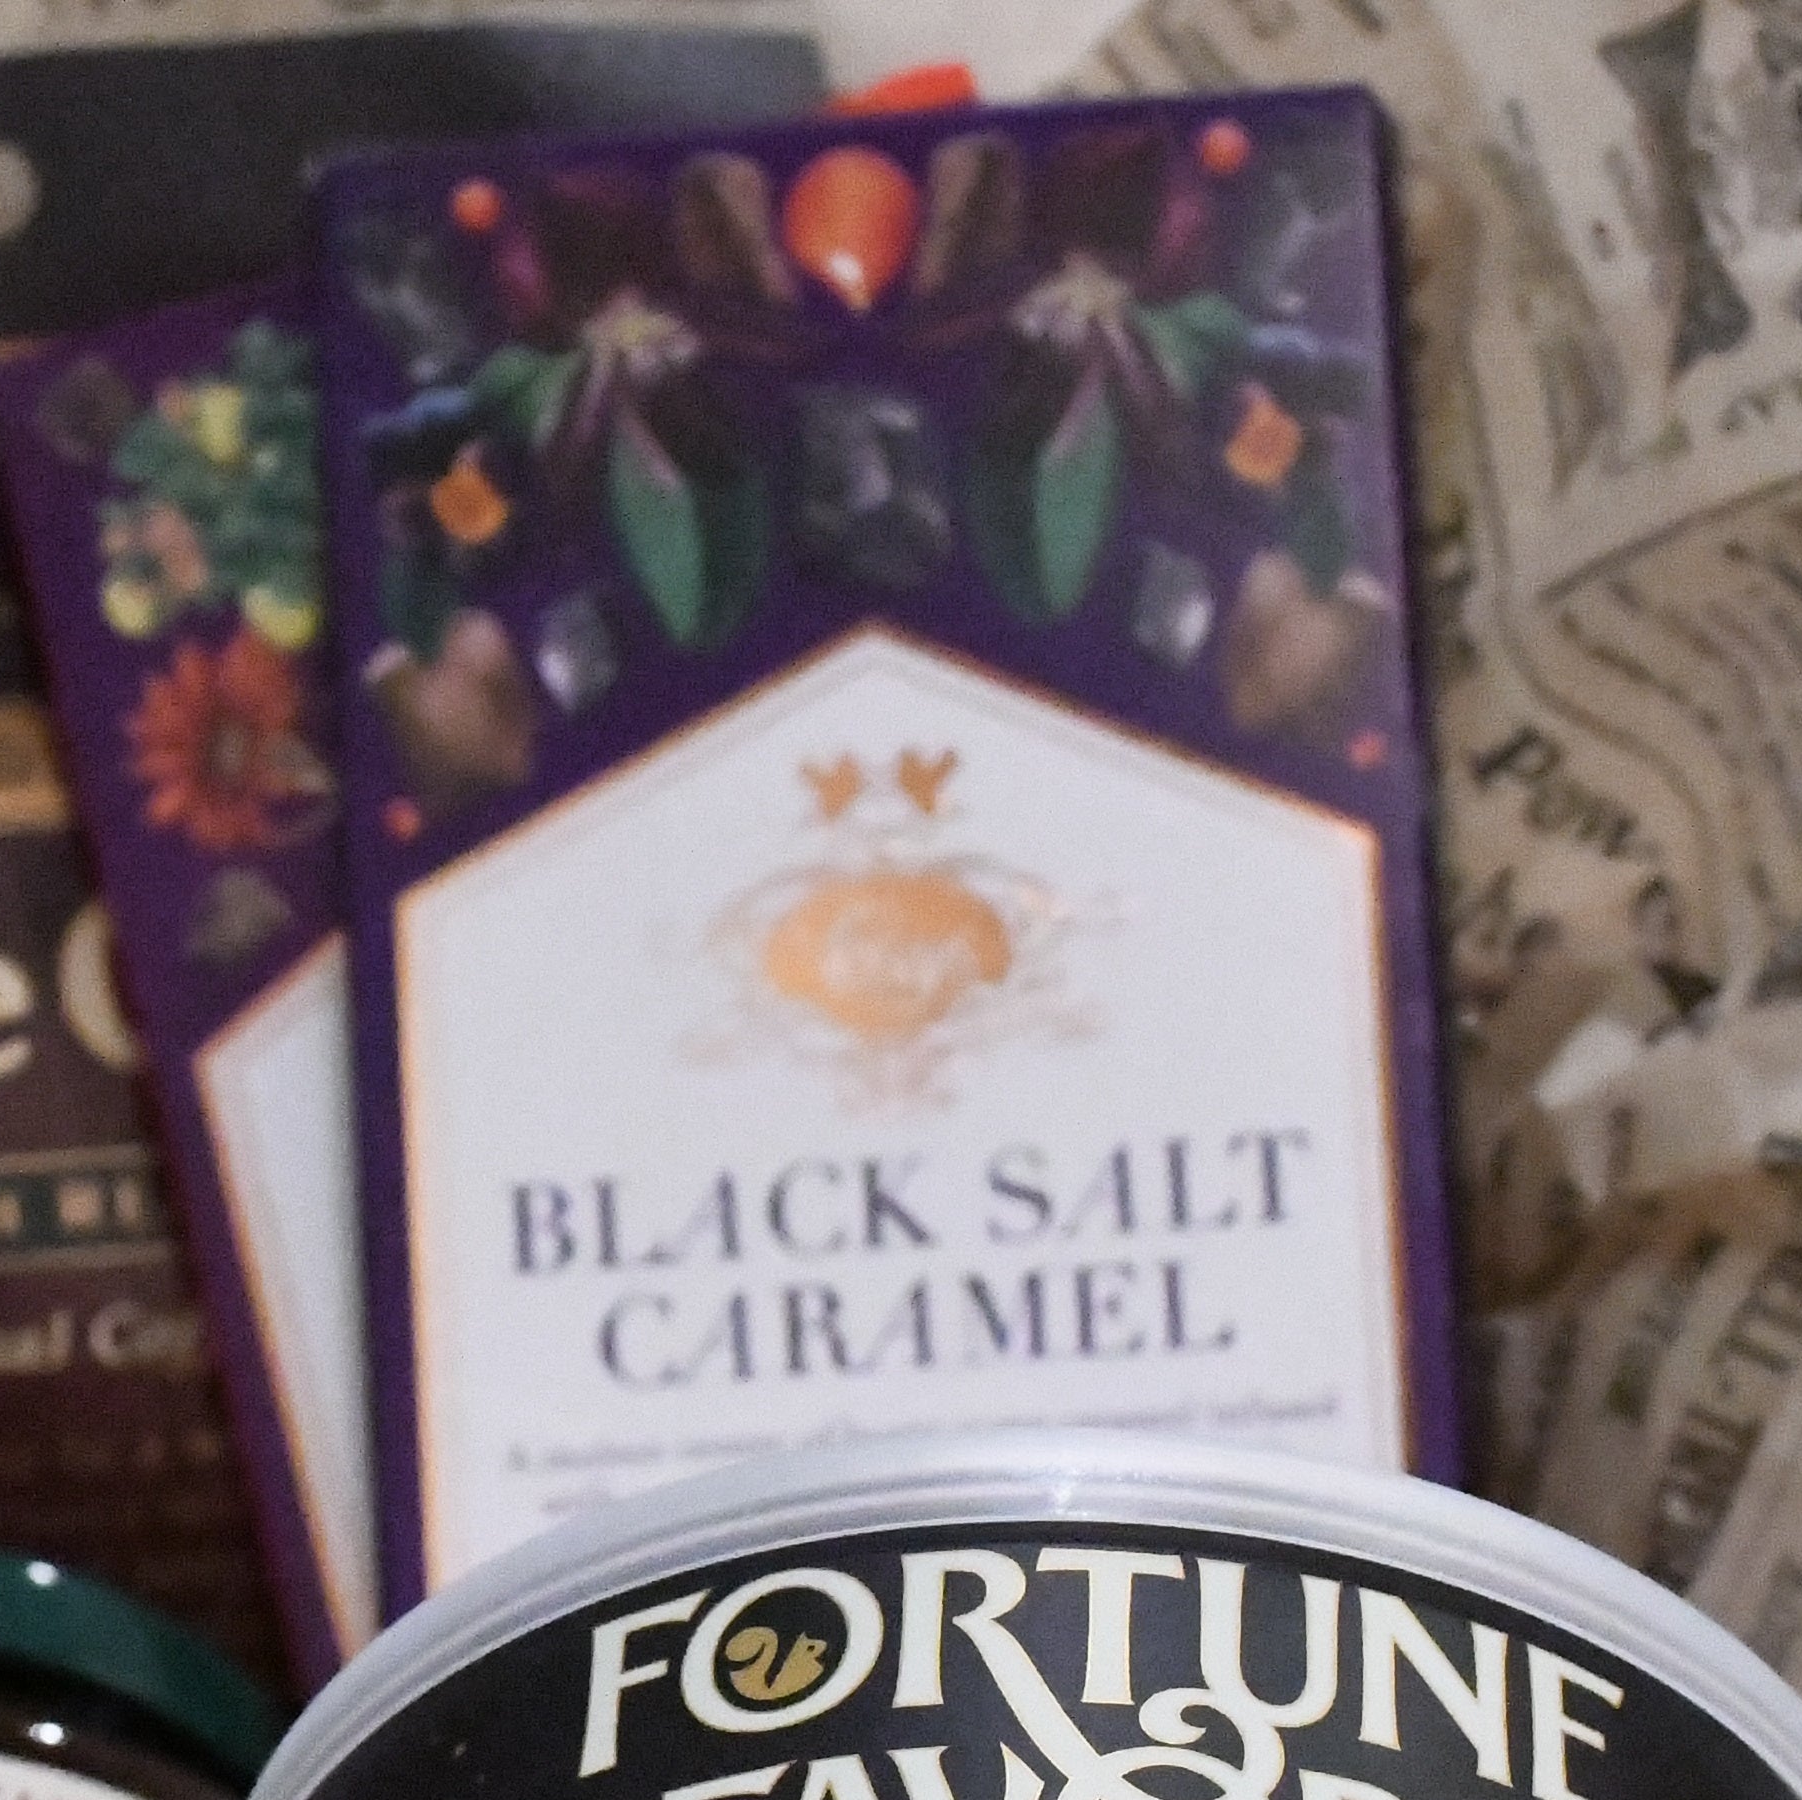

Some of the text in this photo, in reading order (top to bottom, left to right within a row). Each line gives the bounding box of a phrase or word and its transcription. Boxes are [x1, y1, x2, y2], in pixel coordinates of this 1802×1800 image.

[505, 1126, 1313, 1276] BLACK SALT
[597, 1260, 1237, 1392] CARAMEL
